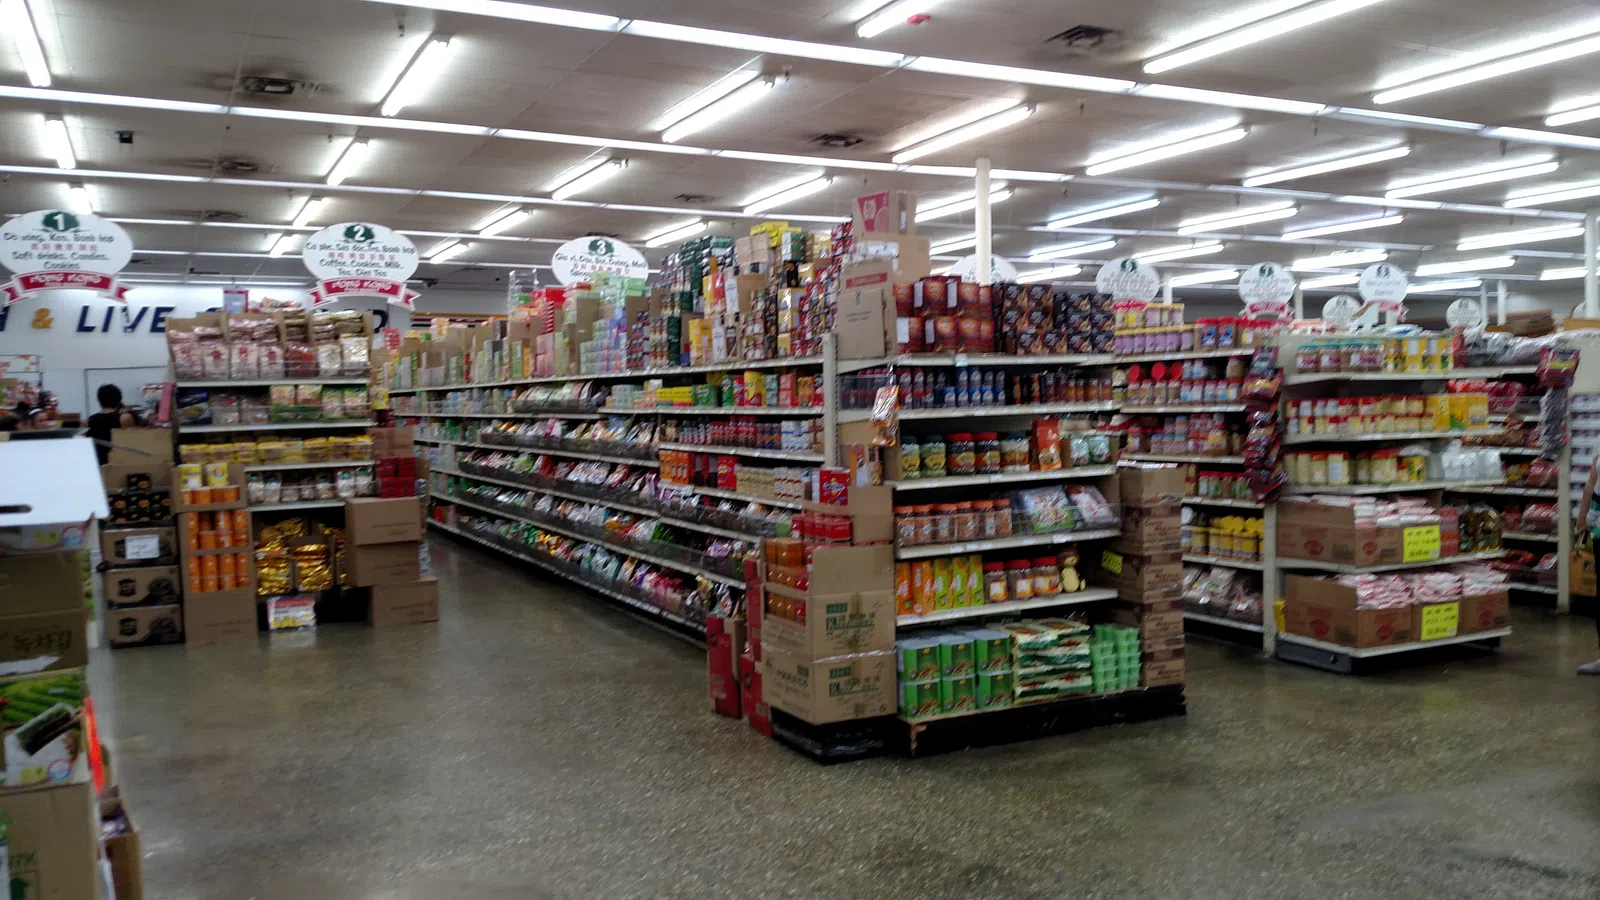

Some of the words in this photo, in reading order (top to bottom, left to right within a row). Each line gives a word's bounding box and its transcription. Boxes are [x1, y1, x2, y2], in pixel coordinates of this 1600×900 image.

[53, 214, 65, 230] 1
[353, 224, 366, 241] 2
[596, 240, 607, 255] 3
[12, 251, 33, 260] Soft
[43, 261, 80, 269] Cookies
[29, 273, 64, 283] HONG
[67, 273, 102, 284] KONG
[332, 279, 361, 289] HONG
[363, 280, 392, 291] KONG
[76, 305, 176, 332] LIVE
